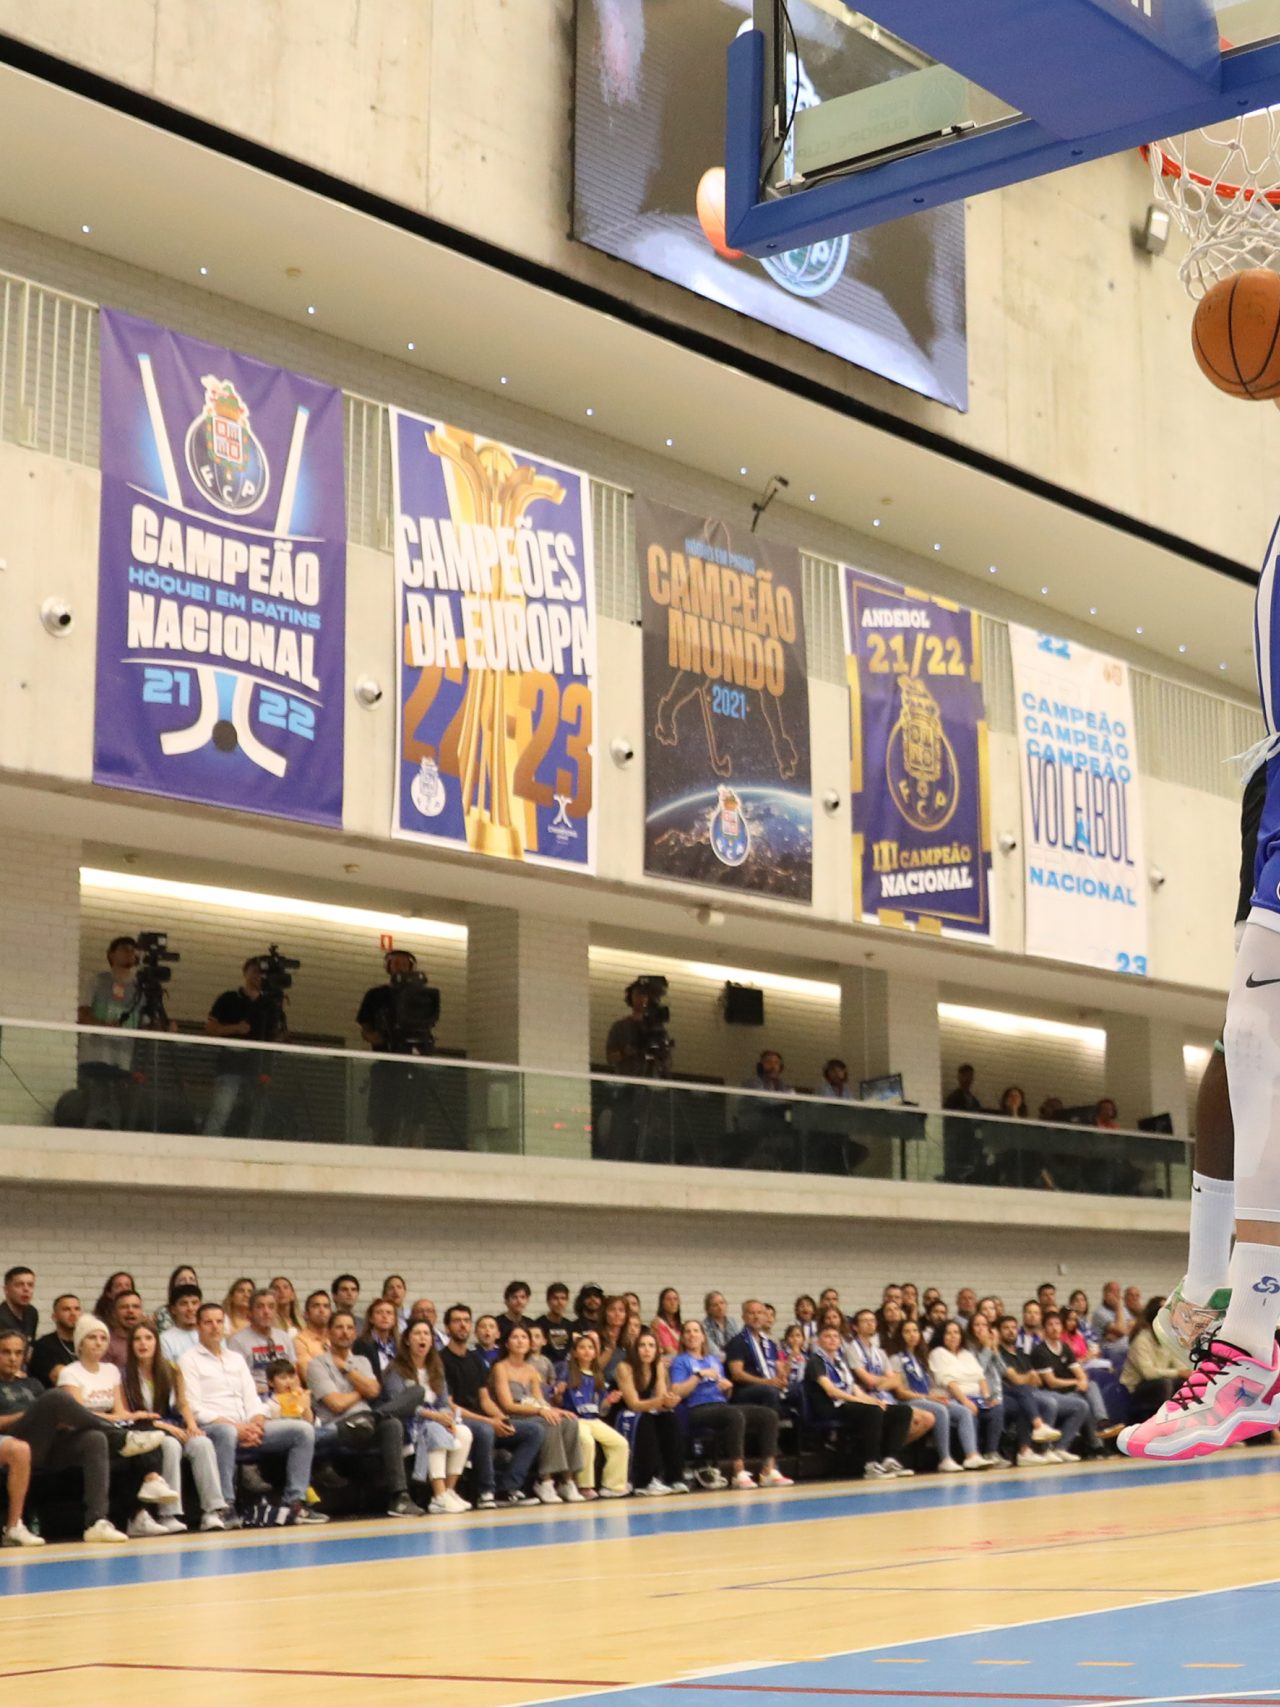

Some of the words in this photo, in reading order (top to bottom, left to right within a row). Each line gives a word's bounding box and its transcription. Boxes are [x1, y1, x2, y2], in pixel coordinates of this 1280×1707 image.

[131, 503, 320, 606] CAMPEÃO
[400, 514, 581, 602] CAMPEÕES
[128, 565, 210, 602] HÓQUEI
[216, 588, 246, 612] EM
[252, 599, 321, 629] PATINS
[647, 544, 796, 644] CAMPEÃO
[127, 590, 321, 692] NACIONAL
[406, 593, 460, 668] DA
[461, 596, 592, 677] EUROPA
[861, 608, 931, 628] ANDEBOL
[668, 607, 785, 697] MUNDO
[866, 633, 966, 678] 21/22
[142, 668, 191, 706] 21
[712, 684, 747, 721] 2021
[258, 689, 316, 741] 22
[1021, 692, 1127, 738] CAMPEÃO
[1024, 715, 1129, 760] CAMPEÃO
[1026, 738, 1132, 784] CAMPEÃO
[1027, 752, 1135, 867] VOLEIBOL
[900, 842, 972, 869] CAMPEÃO
[881, 866, 973, 897] NACIONAL
[1029, 866, 1138, 907] NACIONAL
